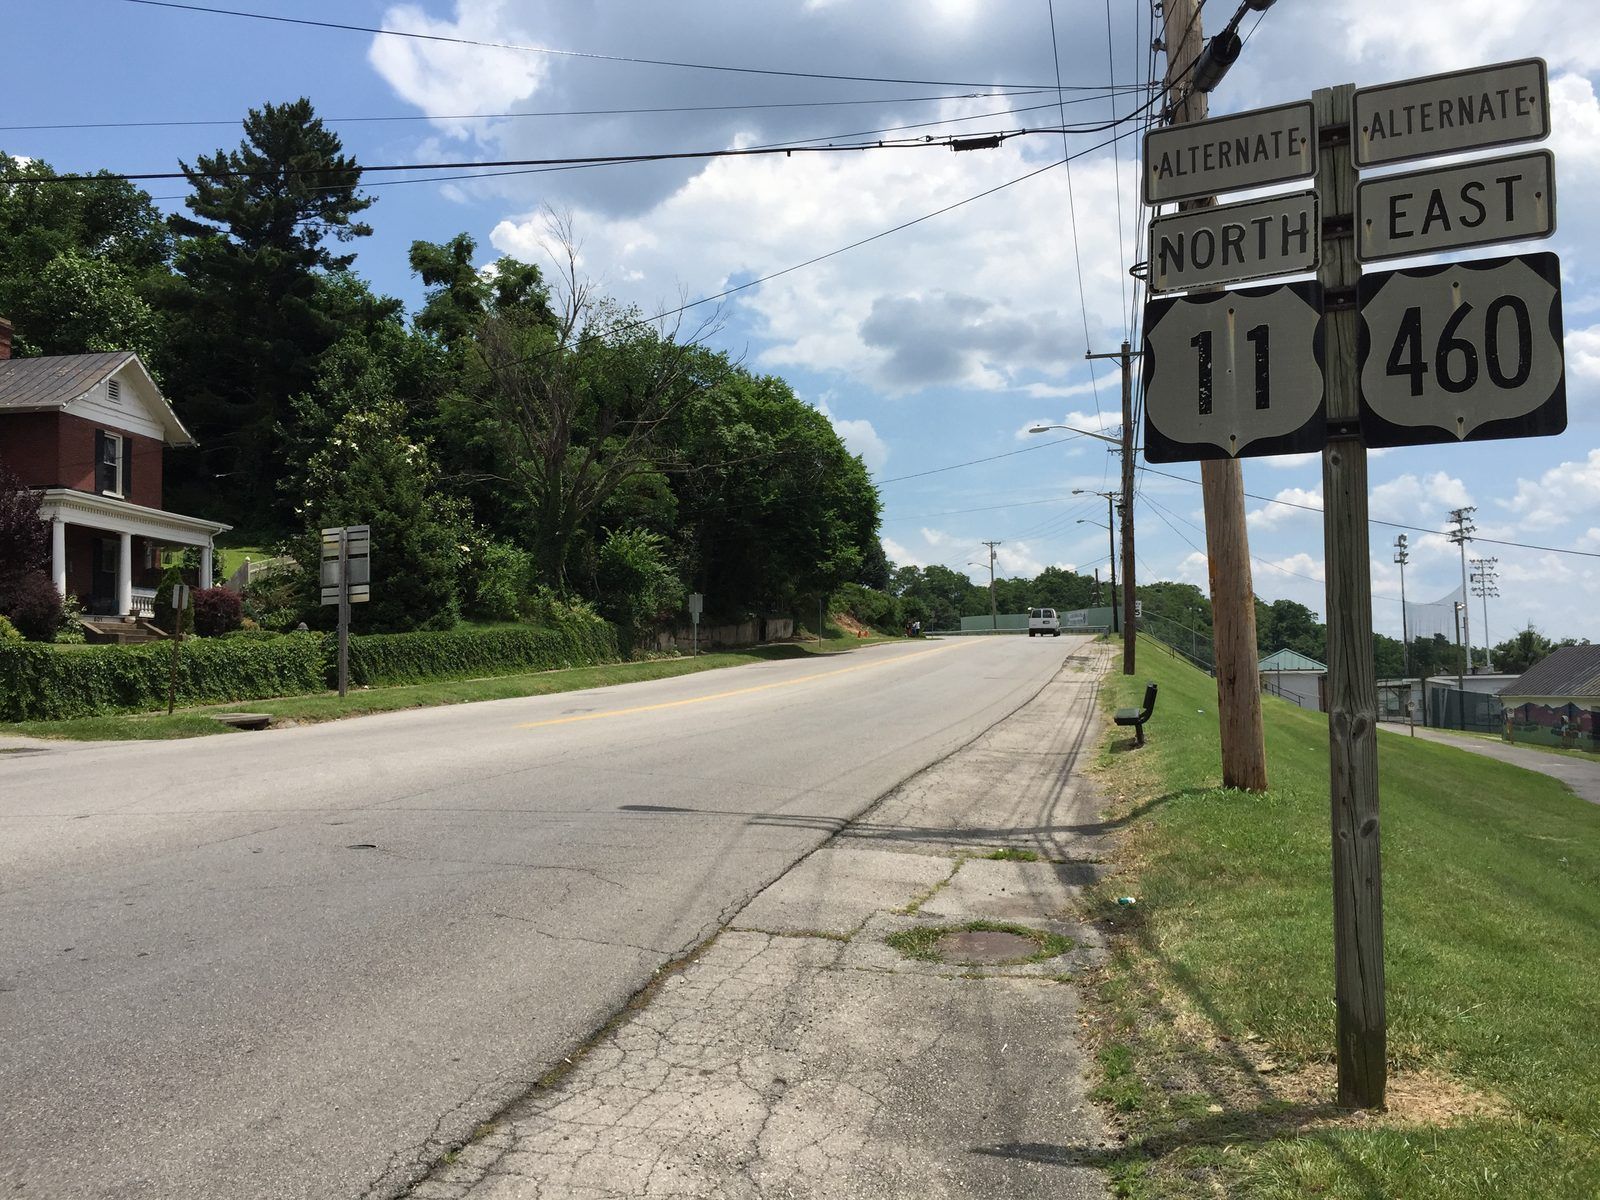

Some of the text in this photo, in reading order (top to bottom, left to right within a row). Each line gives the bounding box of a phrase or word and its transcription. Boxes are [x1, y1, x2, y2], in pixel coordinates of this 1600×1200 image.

[1371, 86, 1530, 142] ALTERNATE
[1159, 127, 1301, 180] ALTERNATE
[1389, 174, 1522, 240] EAST
[1158, 211, 1309, 276] NORTH
[1190, 324, 1270, 415] 11
[1386, 294, 1533, 397] 460
